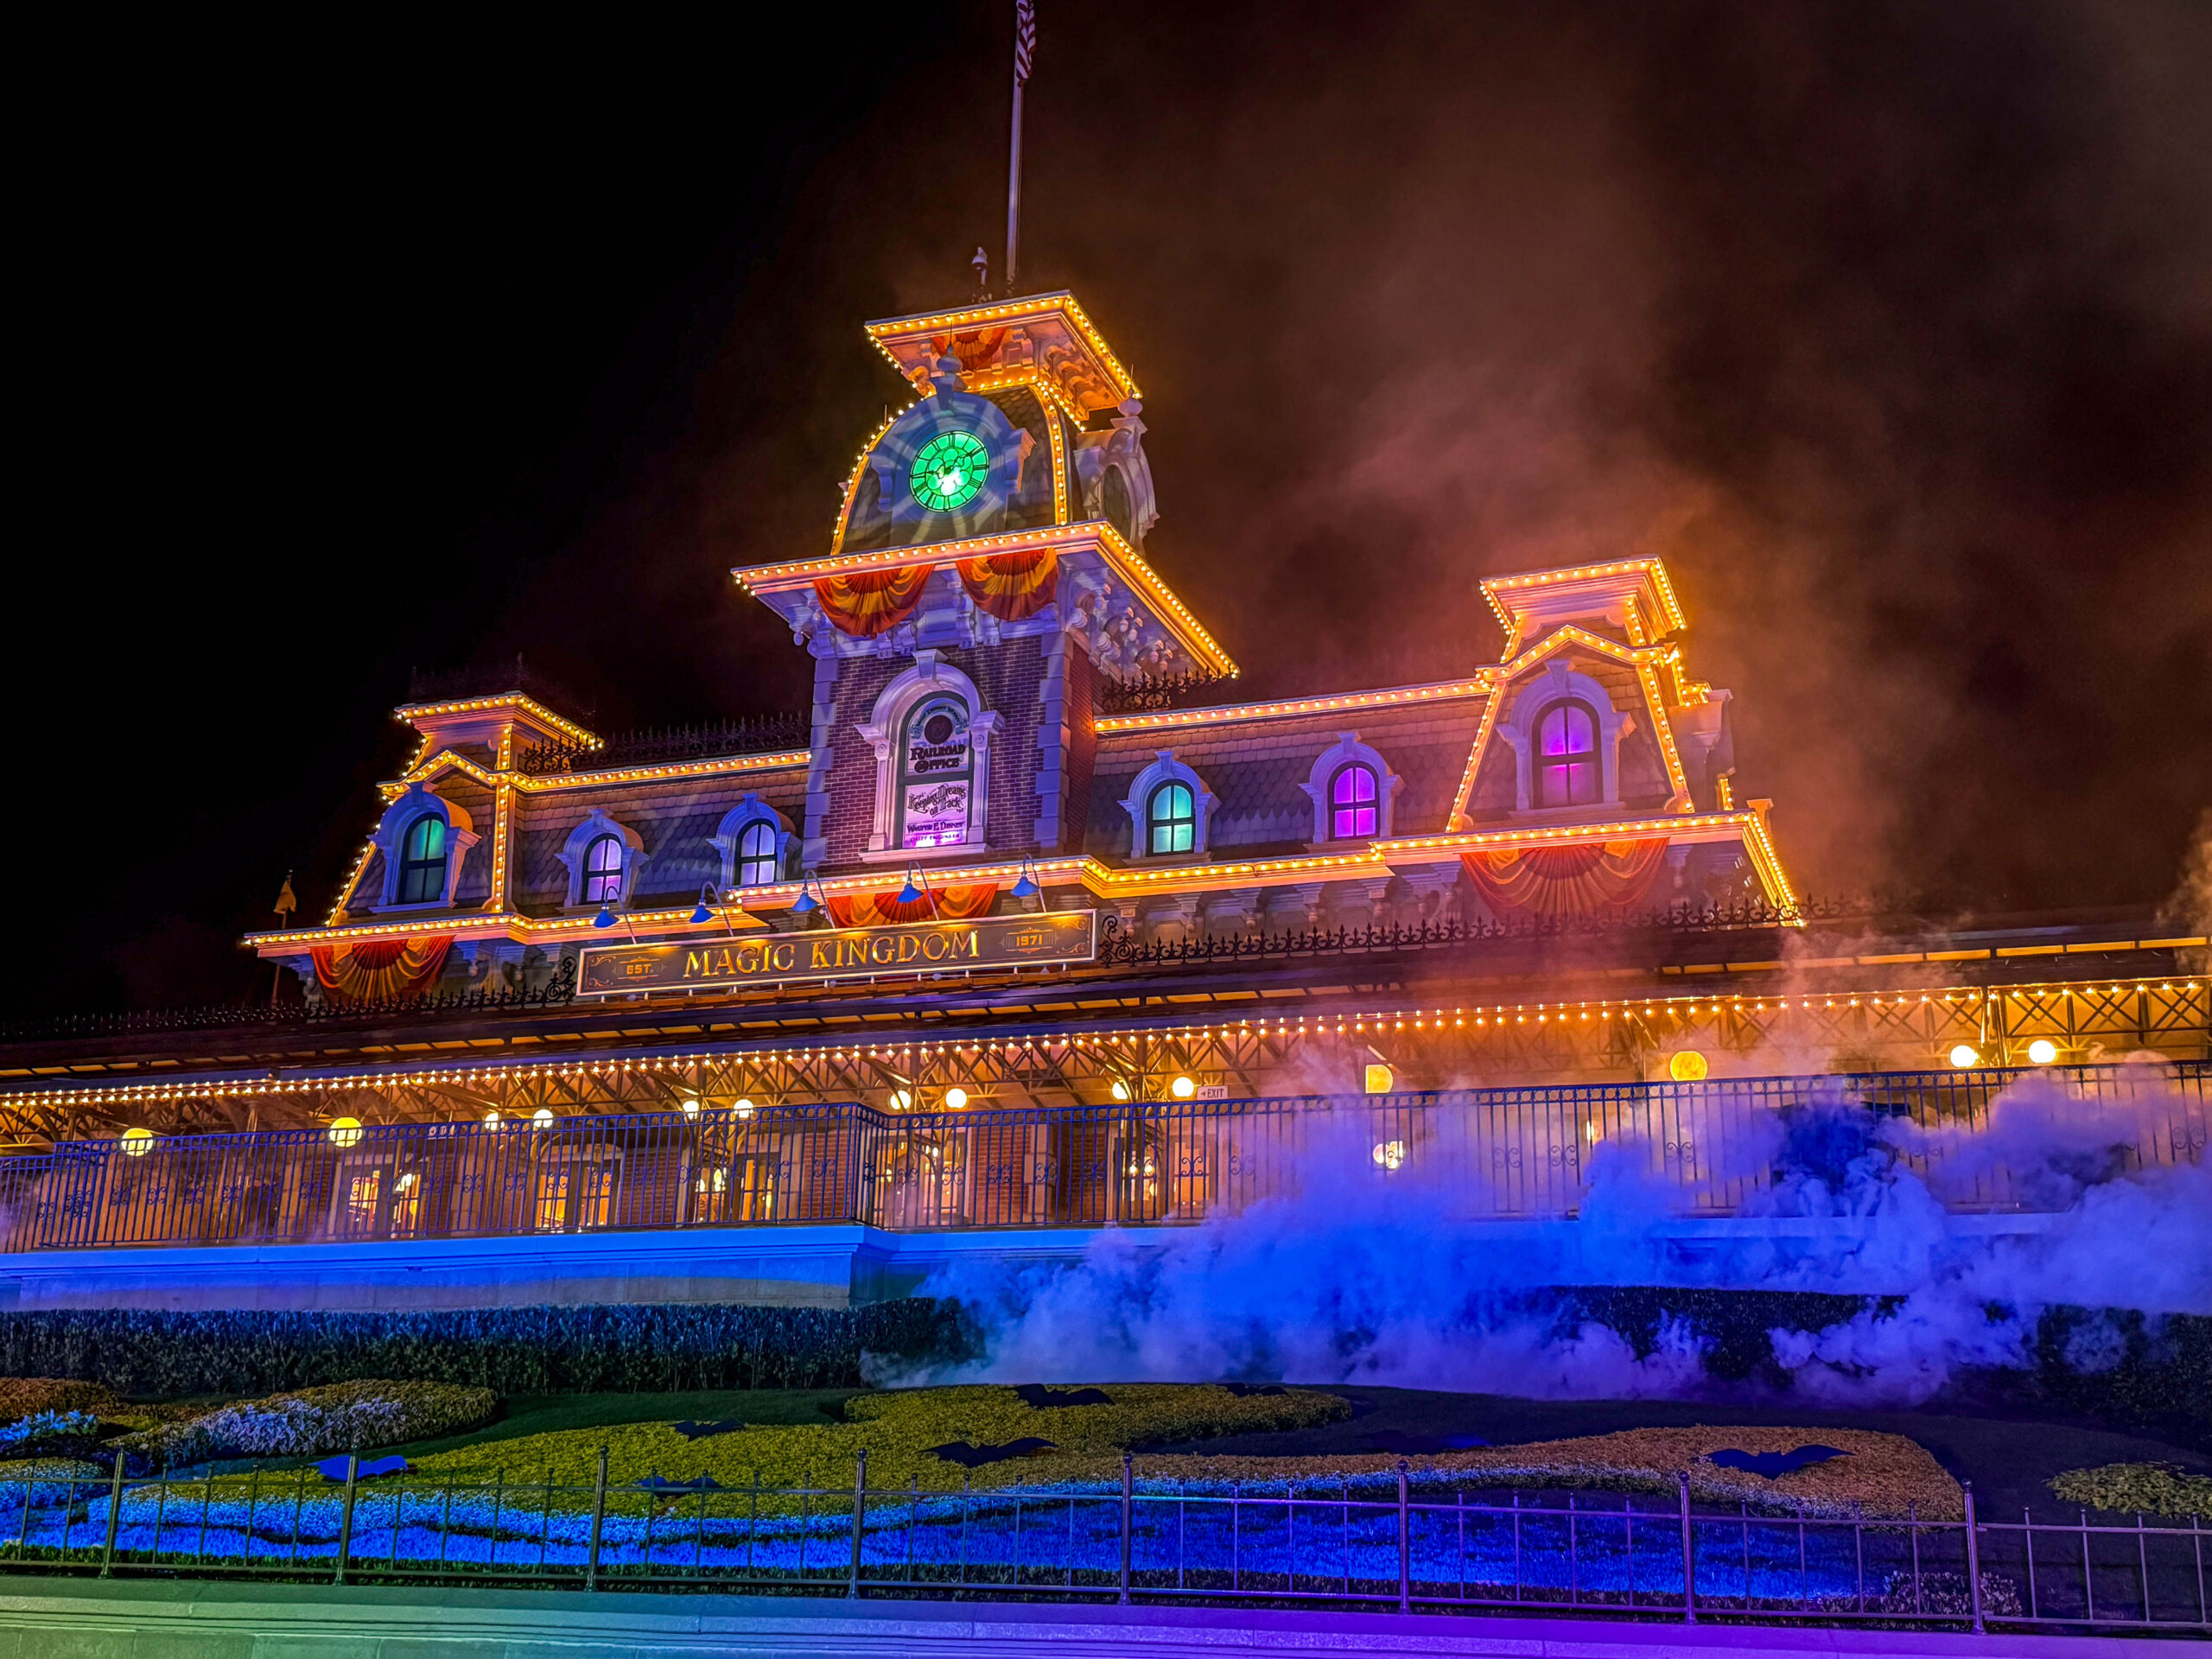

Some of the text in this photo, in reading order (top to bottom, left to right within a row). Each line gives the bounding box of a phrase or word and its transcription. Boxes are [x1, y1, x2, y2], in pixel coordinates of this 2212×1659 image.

[910, 744, 965, 760] RAILROAD
[914, 758, 960, 773] OFFICE
[937, 785, 966, 799] Dreams
[938, 797, 962, 811] Track
[1015, 934, 1044, 947] 1971
[683, 930, 980, 979] MAGIC KINGDOM
[1207, 1089, 1224, 1098] EXIT
